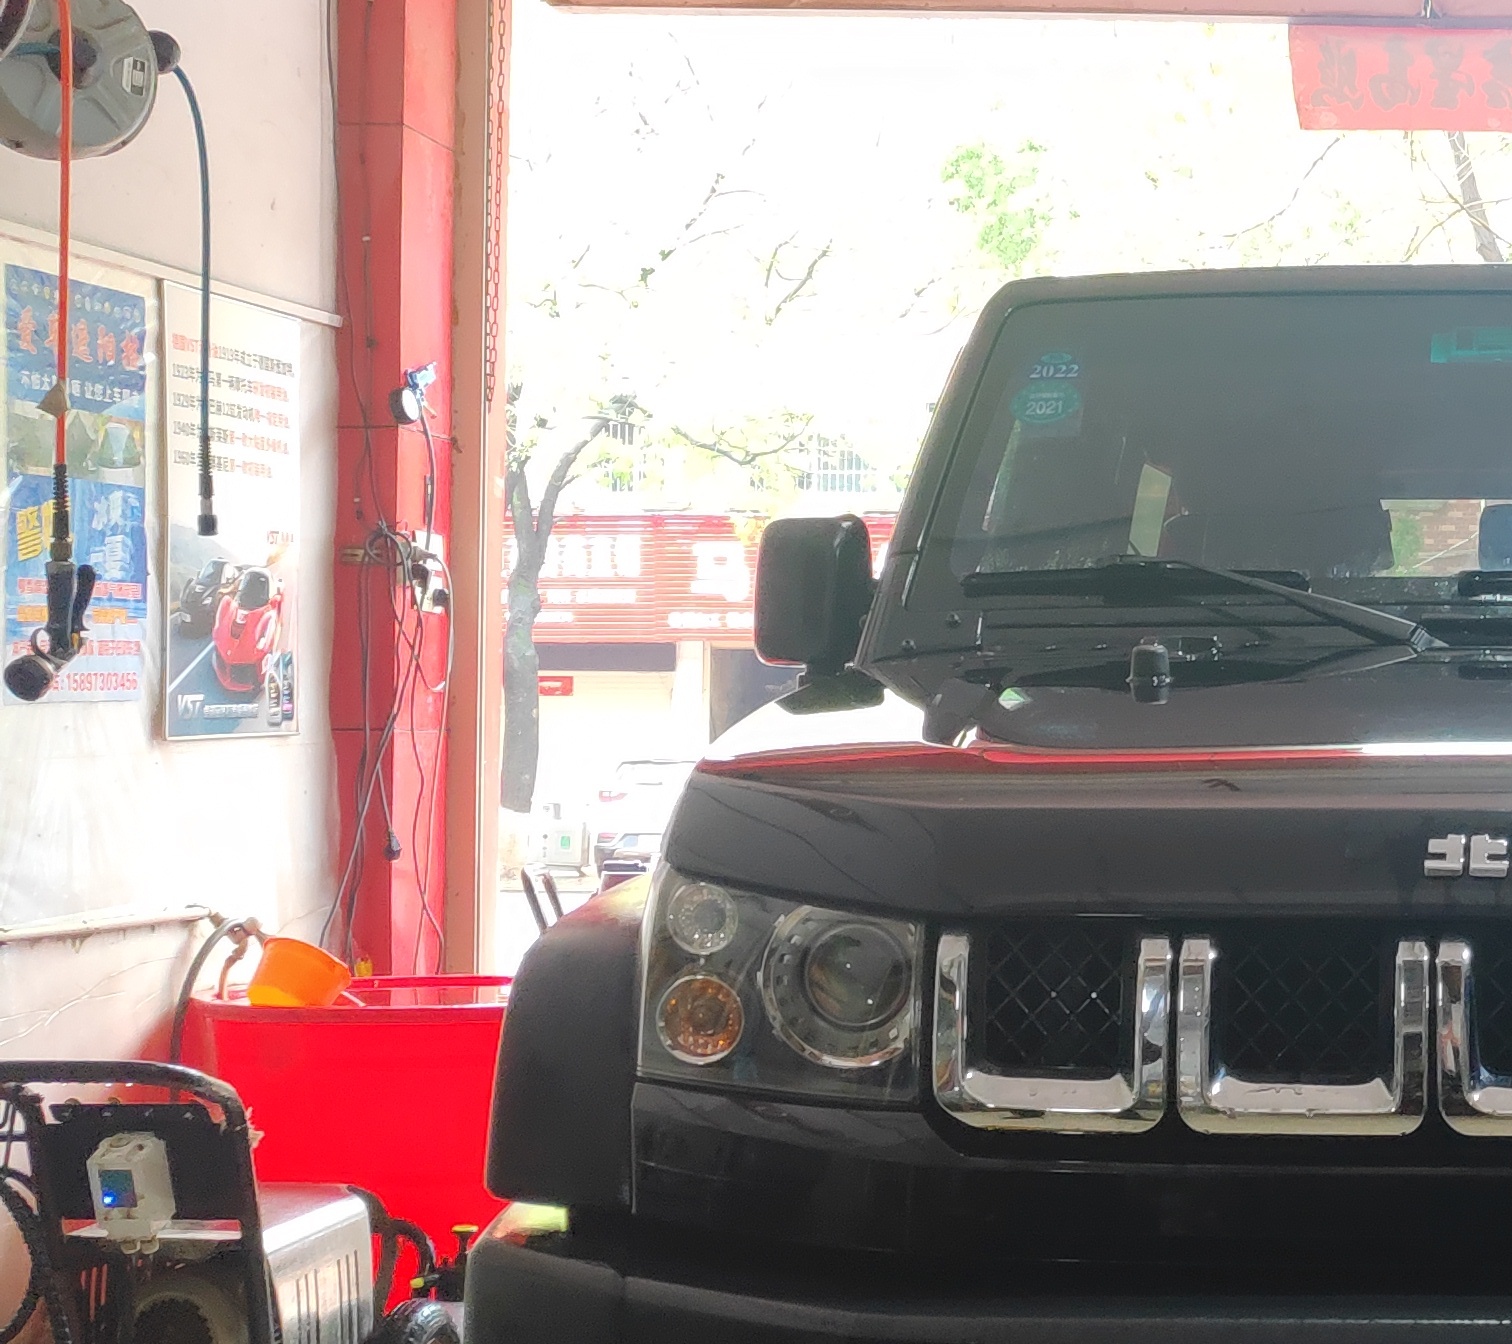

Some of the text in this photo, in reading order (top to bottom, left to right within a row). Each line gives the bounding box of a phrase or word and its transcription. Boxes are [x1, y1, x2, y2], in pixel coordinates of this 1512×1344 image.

[1029, 364, 1079, 378] 2022
[1026, 400, 1062, 415] 2021
[177, 694, 205, 720] VST
